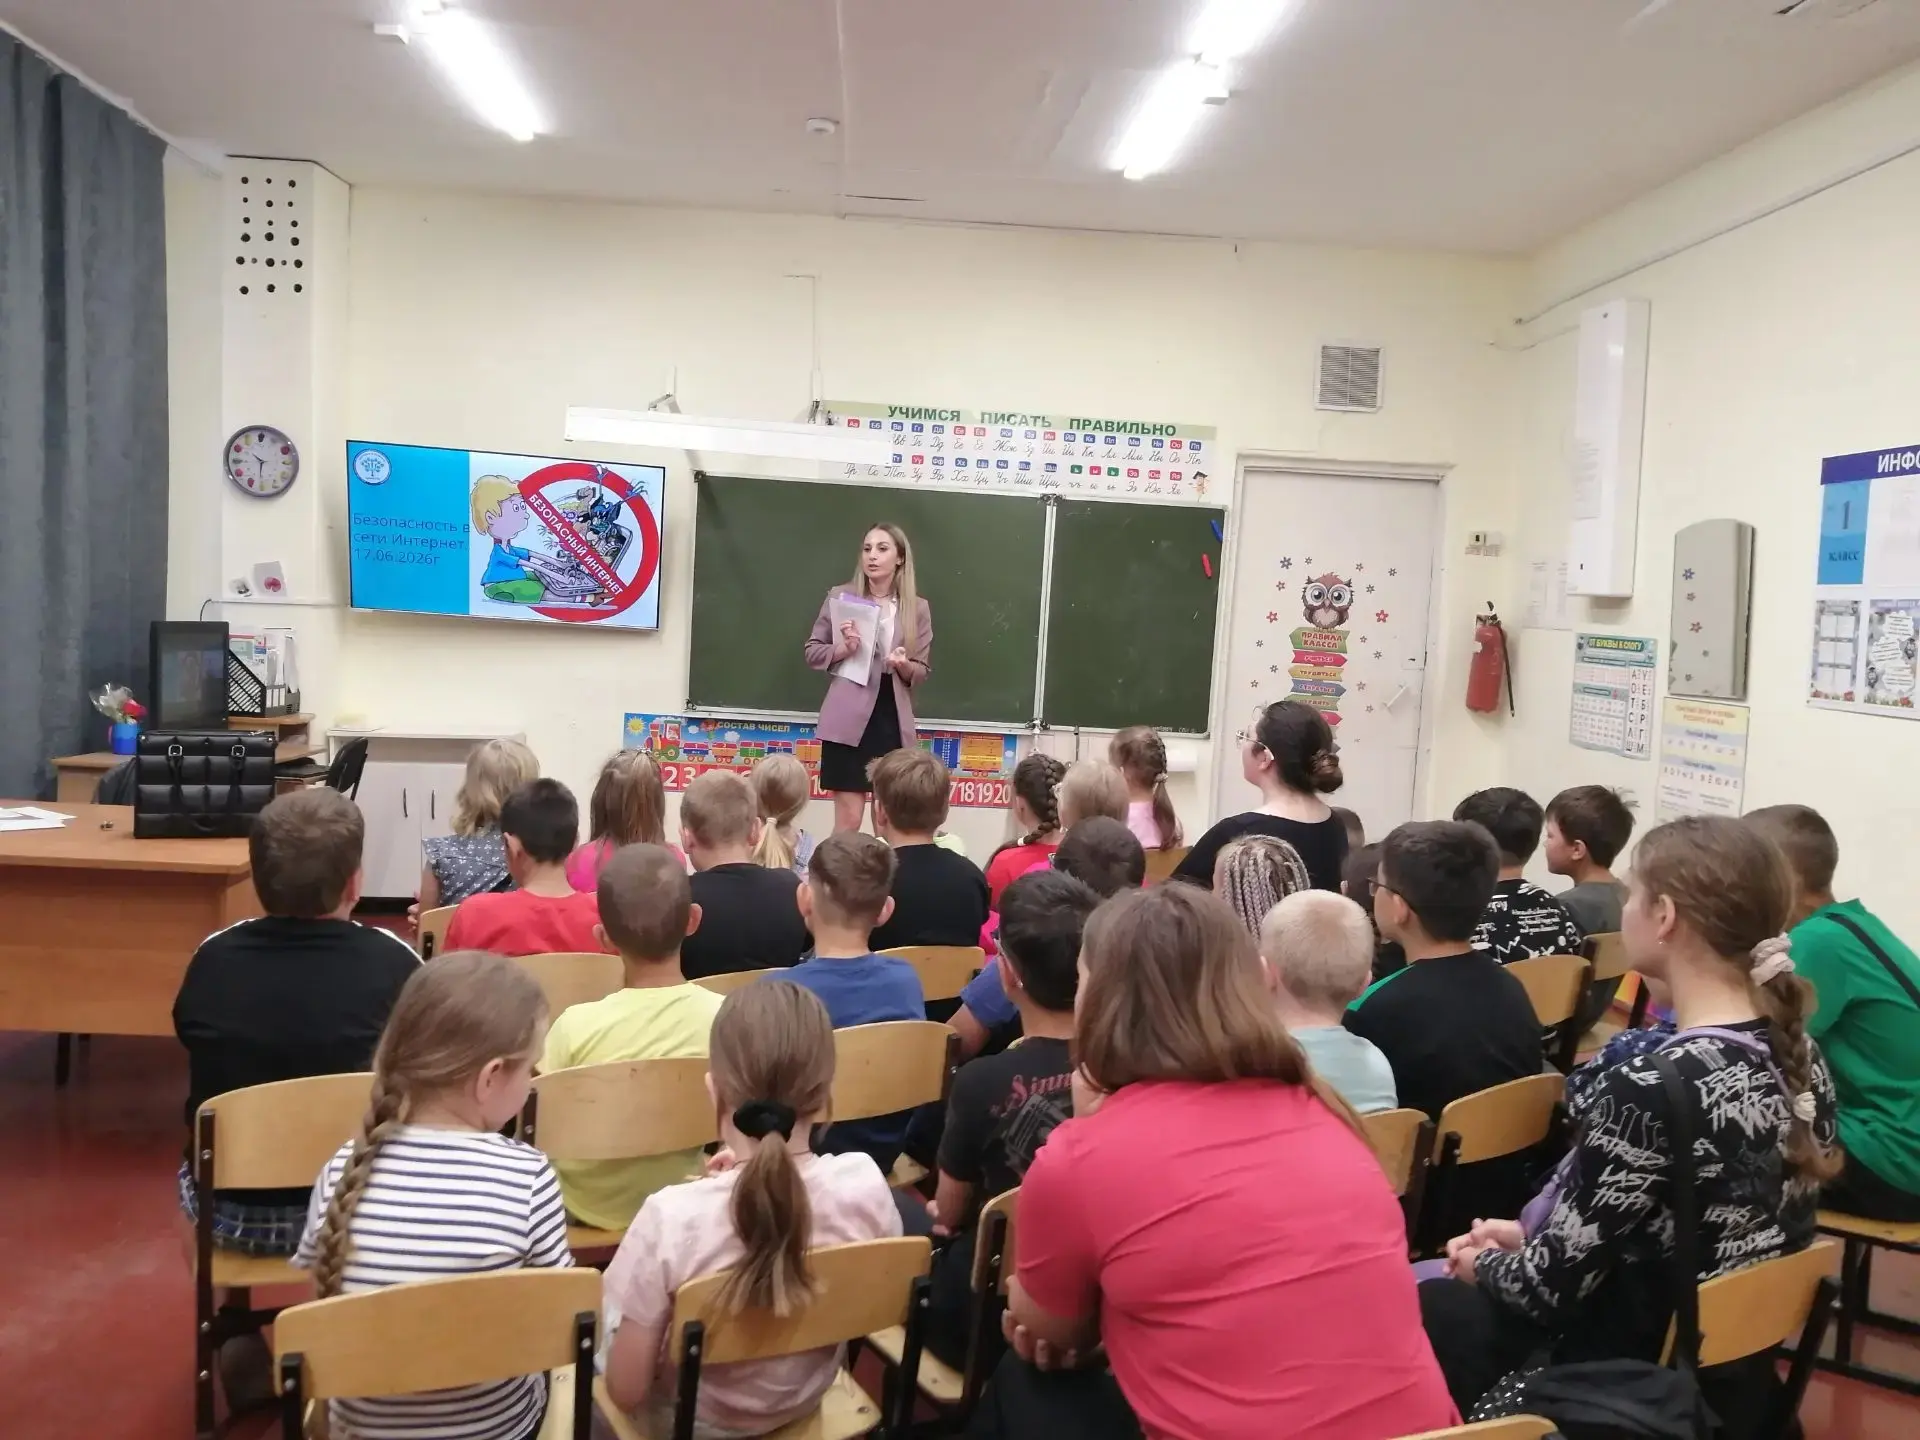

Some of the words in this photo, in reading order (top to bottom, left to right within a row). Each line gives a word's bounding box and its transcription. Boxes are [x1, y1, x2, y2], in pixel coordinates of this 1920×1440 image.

[888, 406, 960, 421] УЧИМСЯ
[981, 412, 1052, 427] ПИСАТЬ
[1070, 418, 1176, 436] ПРАВИЛЬНО
[1842, 500, 1850, 530] 1
[354, 513, 458, 532] Безопасность
[463, 524, 470, 532] в
[354, 533, 386, 544] сети
[529, 494, 588, 556] БЕЗОПАСНЫЙ
[584, 555, 623, 595] ИНТЕРНЕТ
[354, 548, 440, 564] 17.06.2026г
[1302, 632, 1342, 641] ПРАВИЛА
[1304, 640, 1338, 648] КЛАССА
[1642, 685, 1647, 695] Е
[1631, 698, 1635, 708] Т
[1629, 712, 1634, 722] С
[1640, 714, 1645, 724] Р
[718, 721, 756, 730] СОСТАВ
[758, 723, 790, 733] ЧИСЕЛ
[664, 766, 677, 787] 2
[682, 766, 696, 787] 3
[948, 782, 958, 801] 7
[959, 782, 974, 802] 18
[977, 782, 993, 803] 19
[994, 784, 1011, 804] 20
[1598, 1164, 1670, 1191] LAST
